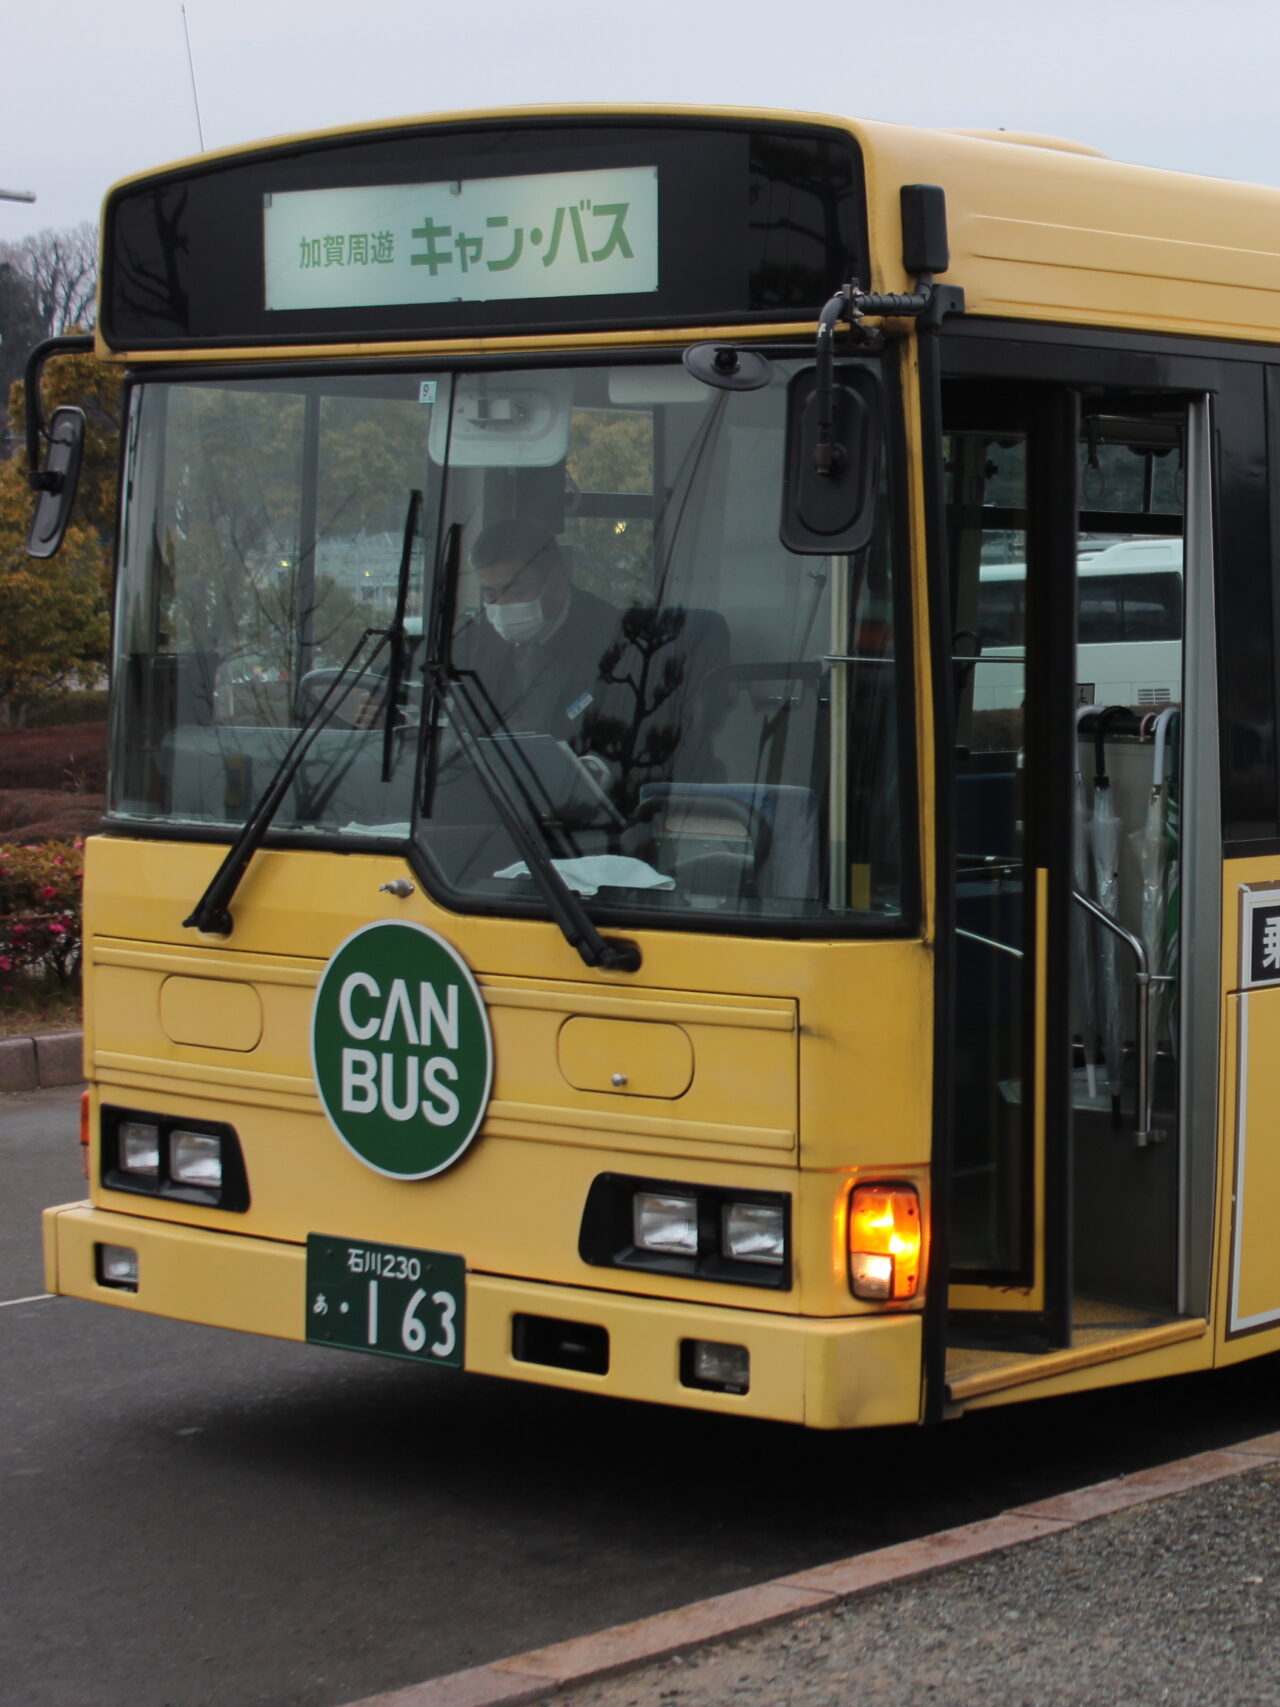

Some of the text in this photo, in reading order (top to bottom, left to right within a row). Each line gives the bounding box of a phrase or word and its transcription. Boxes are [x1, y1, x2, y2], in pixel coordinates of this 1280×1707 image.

[299, 231, 395, 269] 加賀周遊
[338, 971, 459, 1049] CAN
[342, 1047, 460, 1127] BUS
